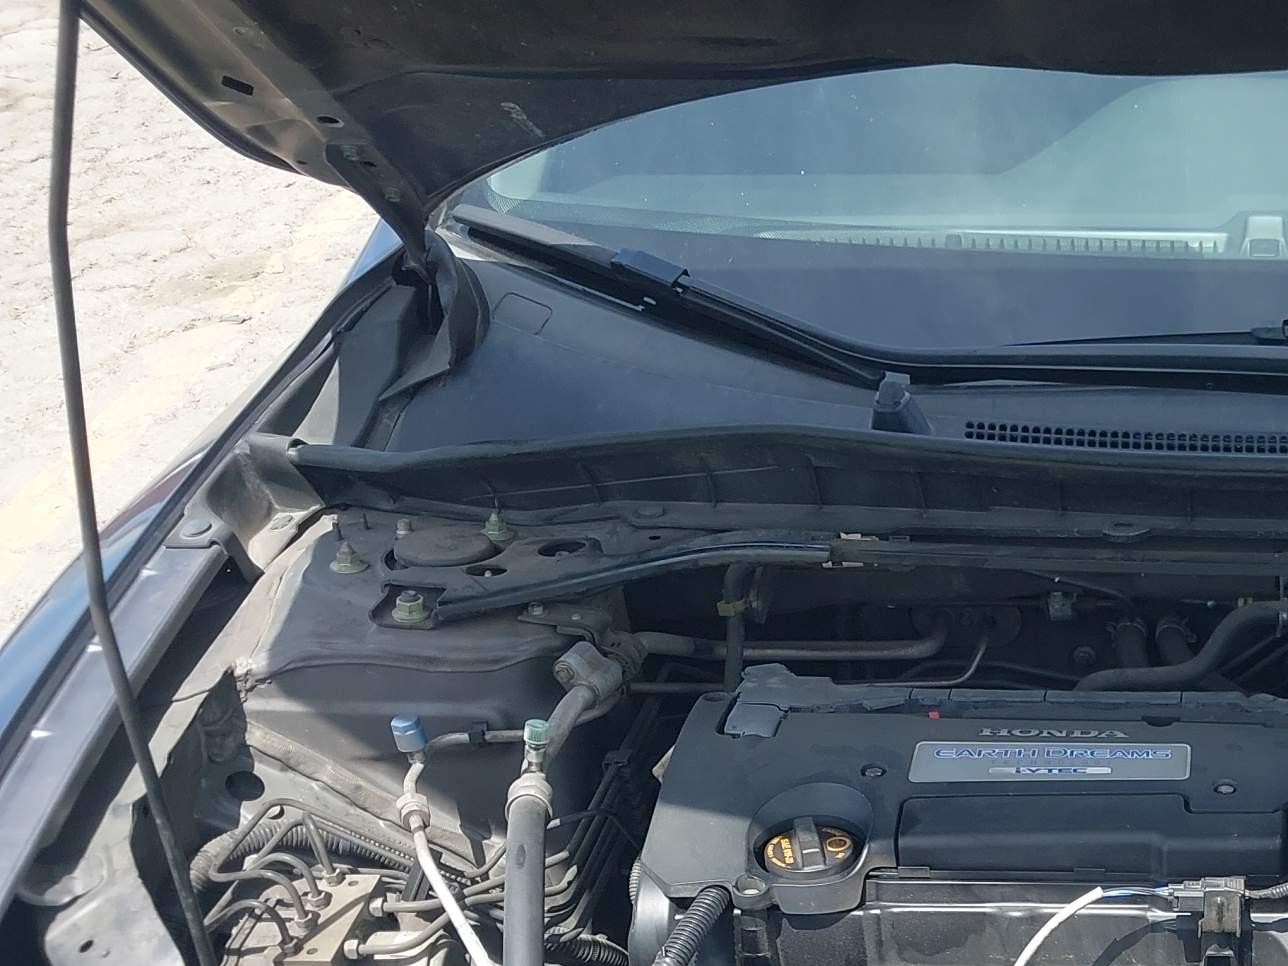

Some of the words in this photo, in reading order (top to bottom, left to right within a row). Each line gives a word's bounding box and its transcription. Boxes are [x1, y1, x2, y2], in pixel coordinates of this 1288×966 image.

[979, 727, 1129, 738] HONDA
[934, 748, 1039, 759] EARTH
[1045, 748, 1172, 759] DREAMS
